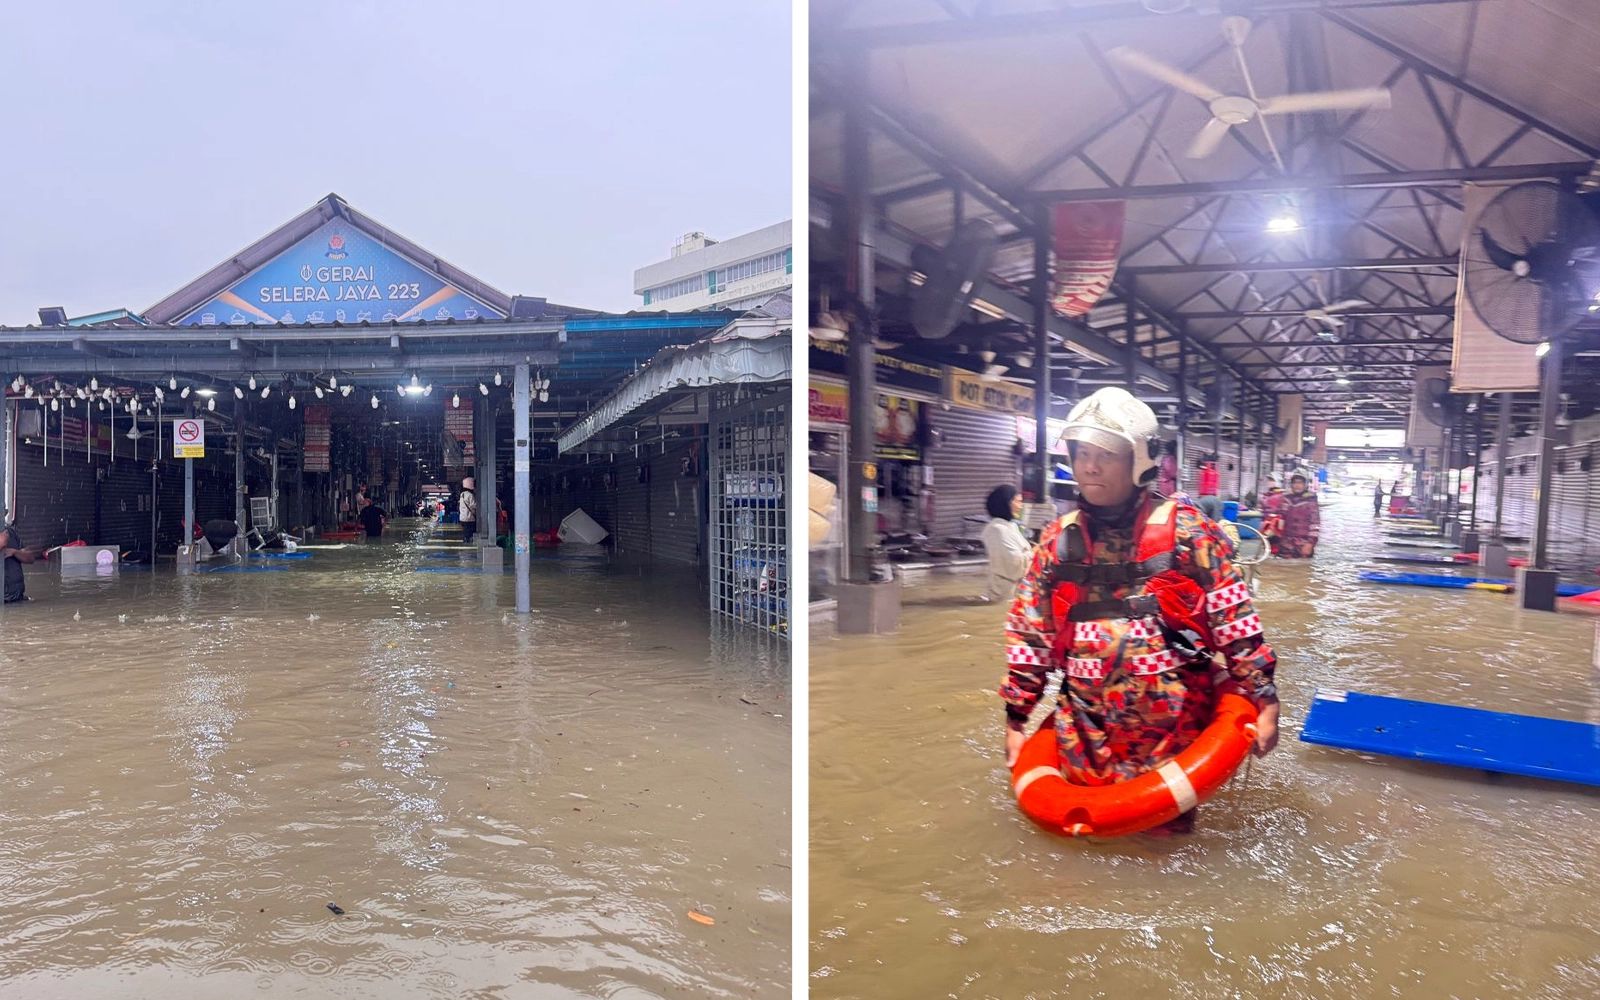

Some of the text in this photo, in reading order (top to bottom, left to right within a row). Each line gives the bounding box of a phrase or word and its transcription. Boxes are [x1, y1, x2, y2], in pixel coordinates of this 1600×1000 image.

[316, 265, 375, 282] GERAI
[260, 283, 420, 302] SELERA JAYA 223
